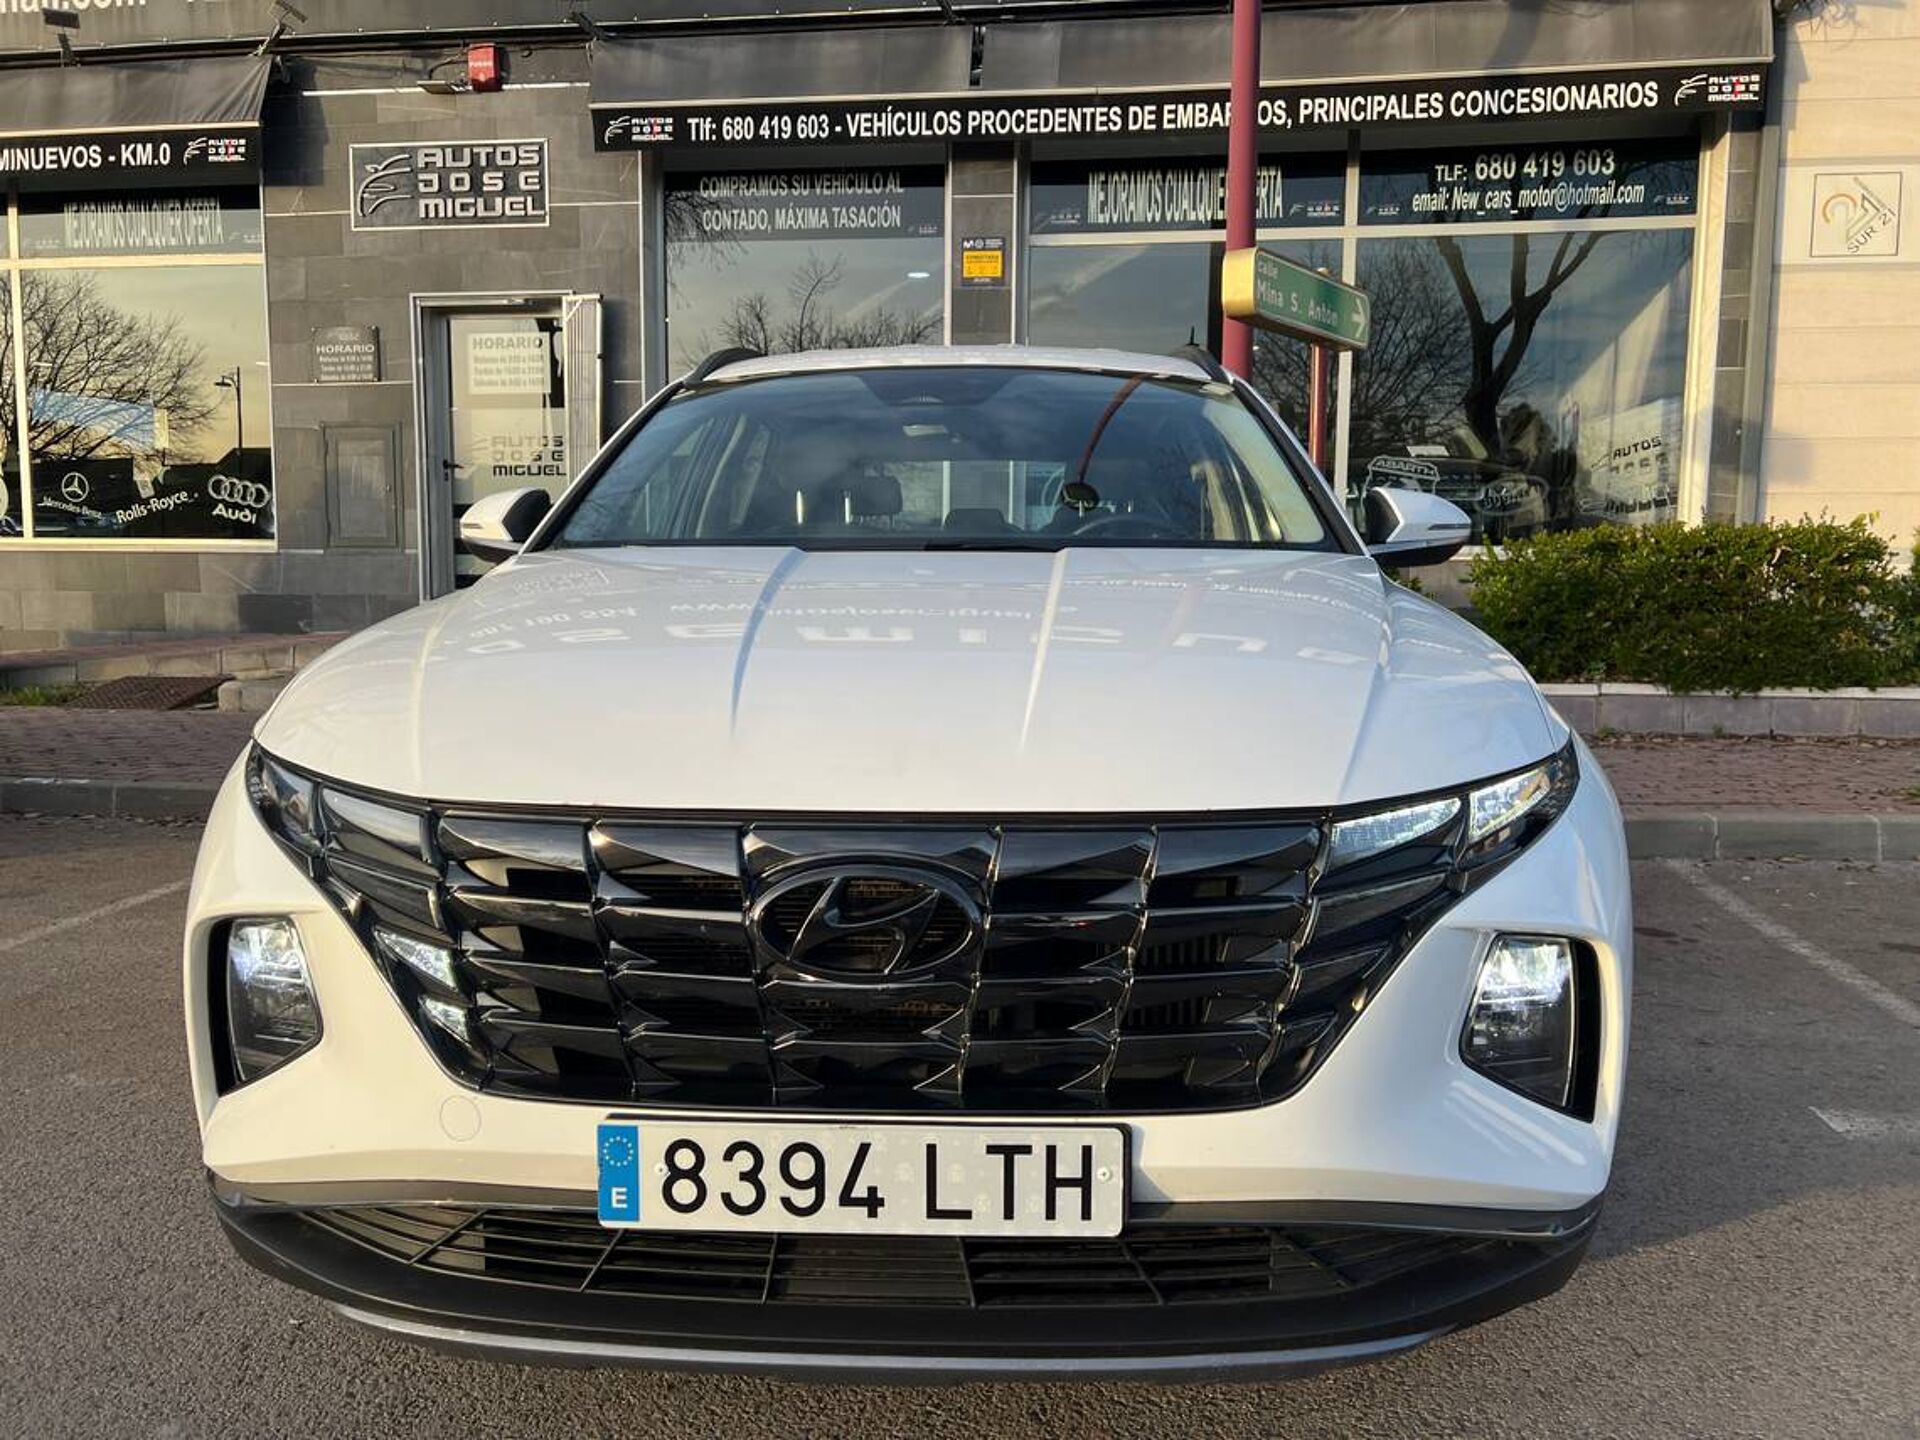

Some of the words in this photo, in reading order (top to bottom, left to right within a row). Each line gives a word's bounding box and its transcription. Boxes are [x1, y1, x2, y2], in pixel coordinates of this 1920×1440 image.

[687, 116, 717, 141] Tlf:
[722, 115, 754, 141] 680
[759, 114, 792, 140] 419
[797, 114, 829, 139] 603
[846, 106, 961, 138] VEHÍCULOS
[967, 106, 1122, 135] PROCEDENTES
[1128, 104, 1159, 132] DE
[1300, 92, 1443, 124] PRINCIPALES
[1450, 81, 1658, 117] CONCESIONARIOS
[121, 143, 170, 166] KM.0
[417, 145, 540, 168] AUTOS
[1435, 164, 1468, 183] TLF:
[1475, 154, 1517, 181] 680
[1523, 151, 1565, 179] 419
[1573, 150, 1615, 177] 603
[417, 170, 540, 193] JOSE
[700, 176, 788, 198] COMPRAMOS
[792, 174, 810, 196] SU
[885, 172, 904, 194] AL
[419, 195, 546, 218] MIGUEL
[1088, 171, 1163, 225] MEJORAMOS
[703, 207, 771, 233] CONTADO,
[775, 202, 829, 230] MÁXIMA
[832, 199, 901, 228] TASACIÓN
[316, 343, 375, 355] HORARIO
[472, 336, 543, 350] HORARIO
[492, 435, 564, 448] AUTOS
[1612, 435, 1662, 460] AUTOS
[493, 464, 567, 477] MIGUEL
[116, 490, 188, 524] Rolls-Royce
[211, 503, 258, 525] Audi
[661, 1137, 885, 1219] 8394
[925, 1142, 1093, 1222] LTH
[610, 1186, 628, 1209] E
